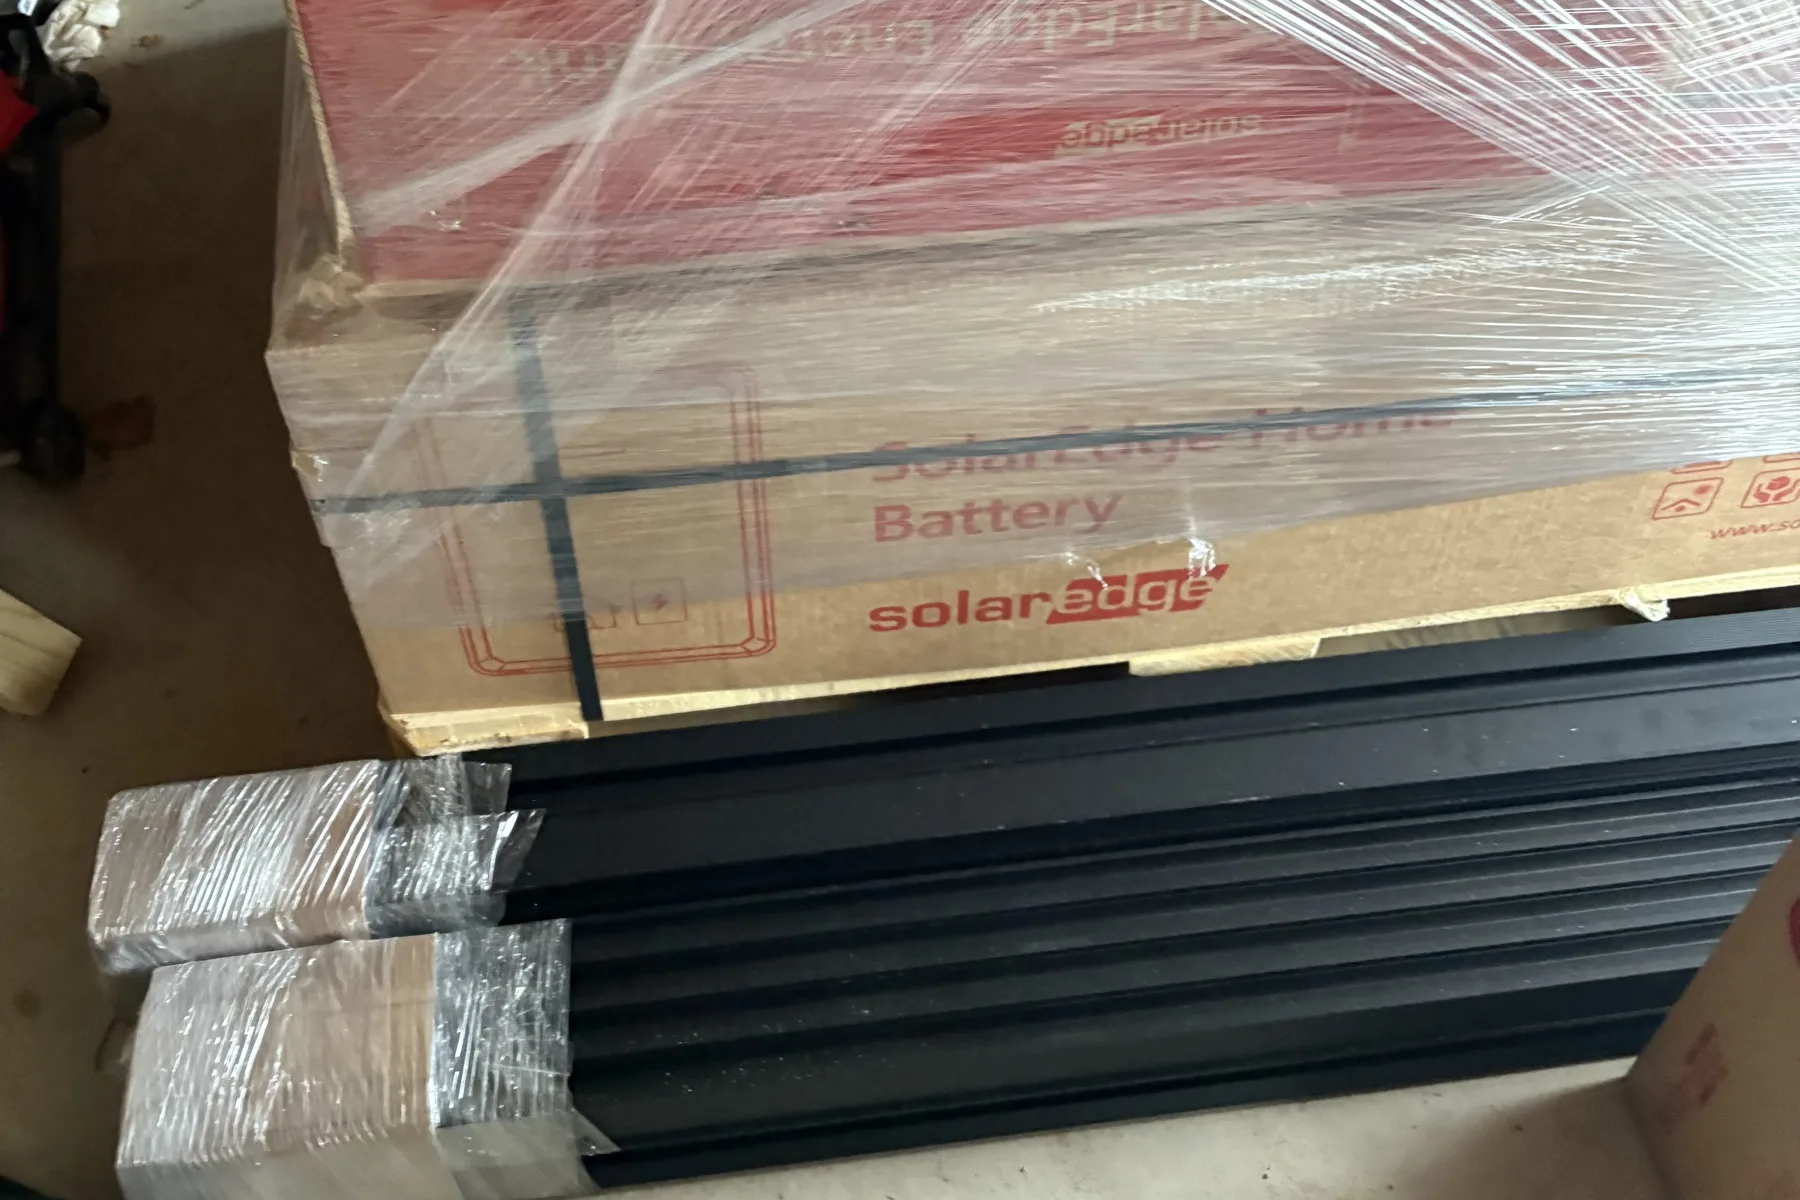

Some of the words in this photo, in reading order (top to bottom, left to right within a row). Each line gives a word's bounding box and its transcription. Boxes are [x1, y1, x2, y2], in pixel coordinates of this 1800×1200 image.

[1053, 112, 1264, 159] solaredge
[874, 492, 1124, 543] Battery
[868, 563, 1230, 633] solaredge
